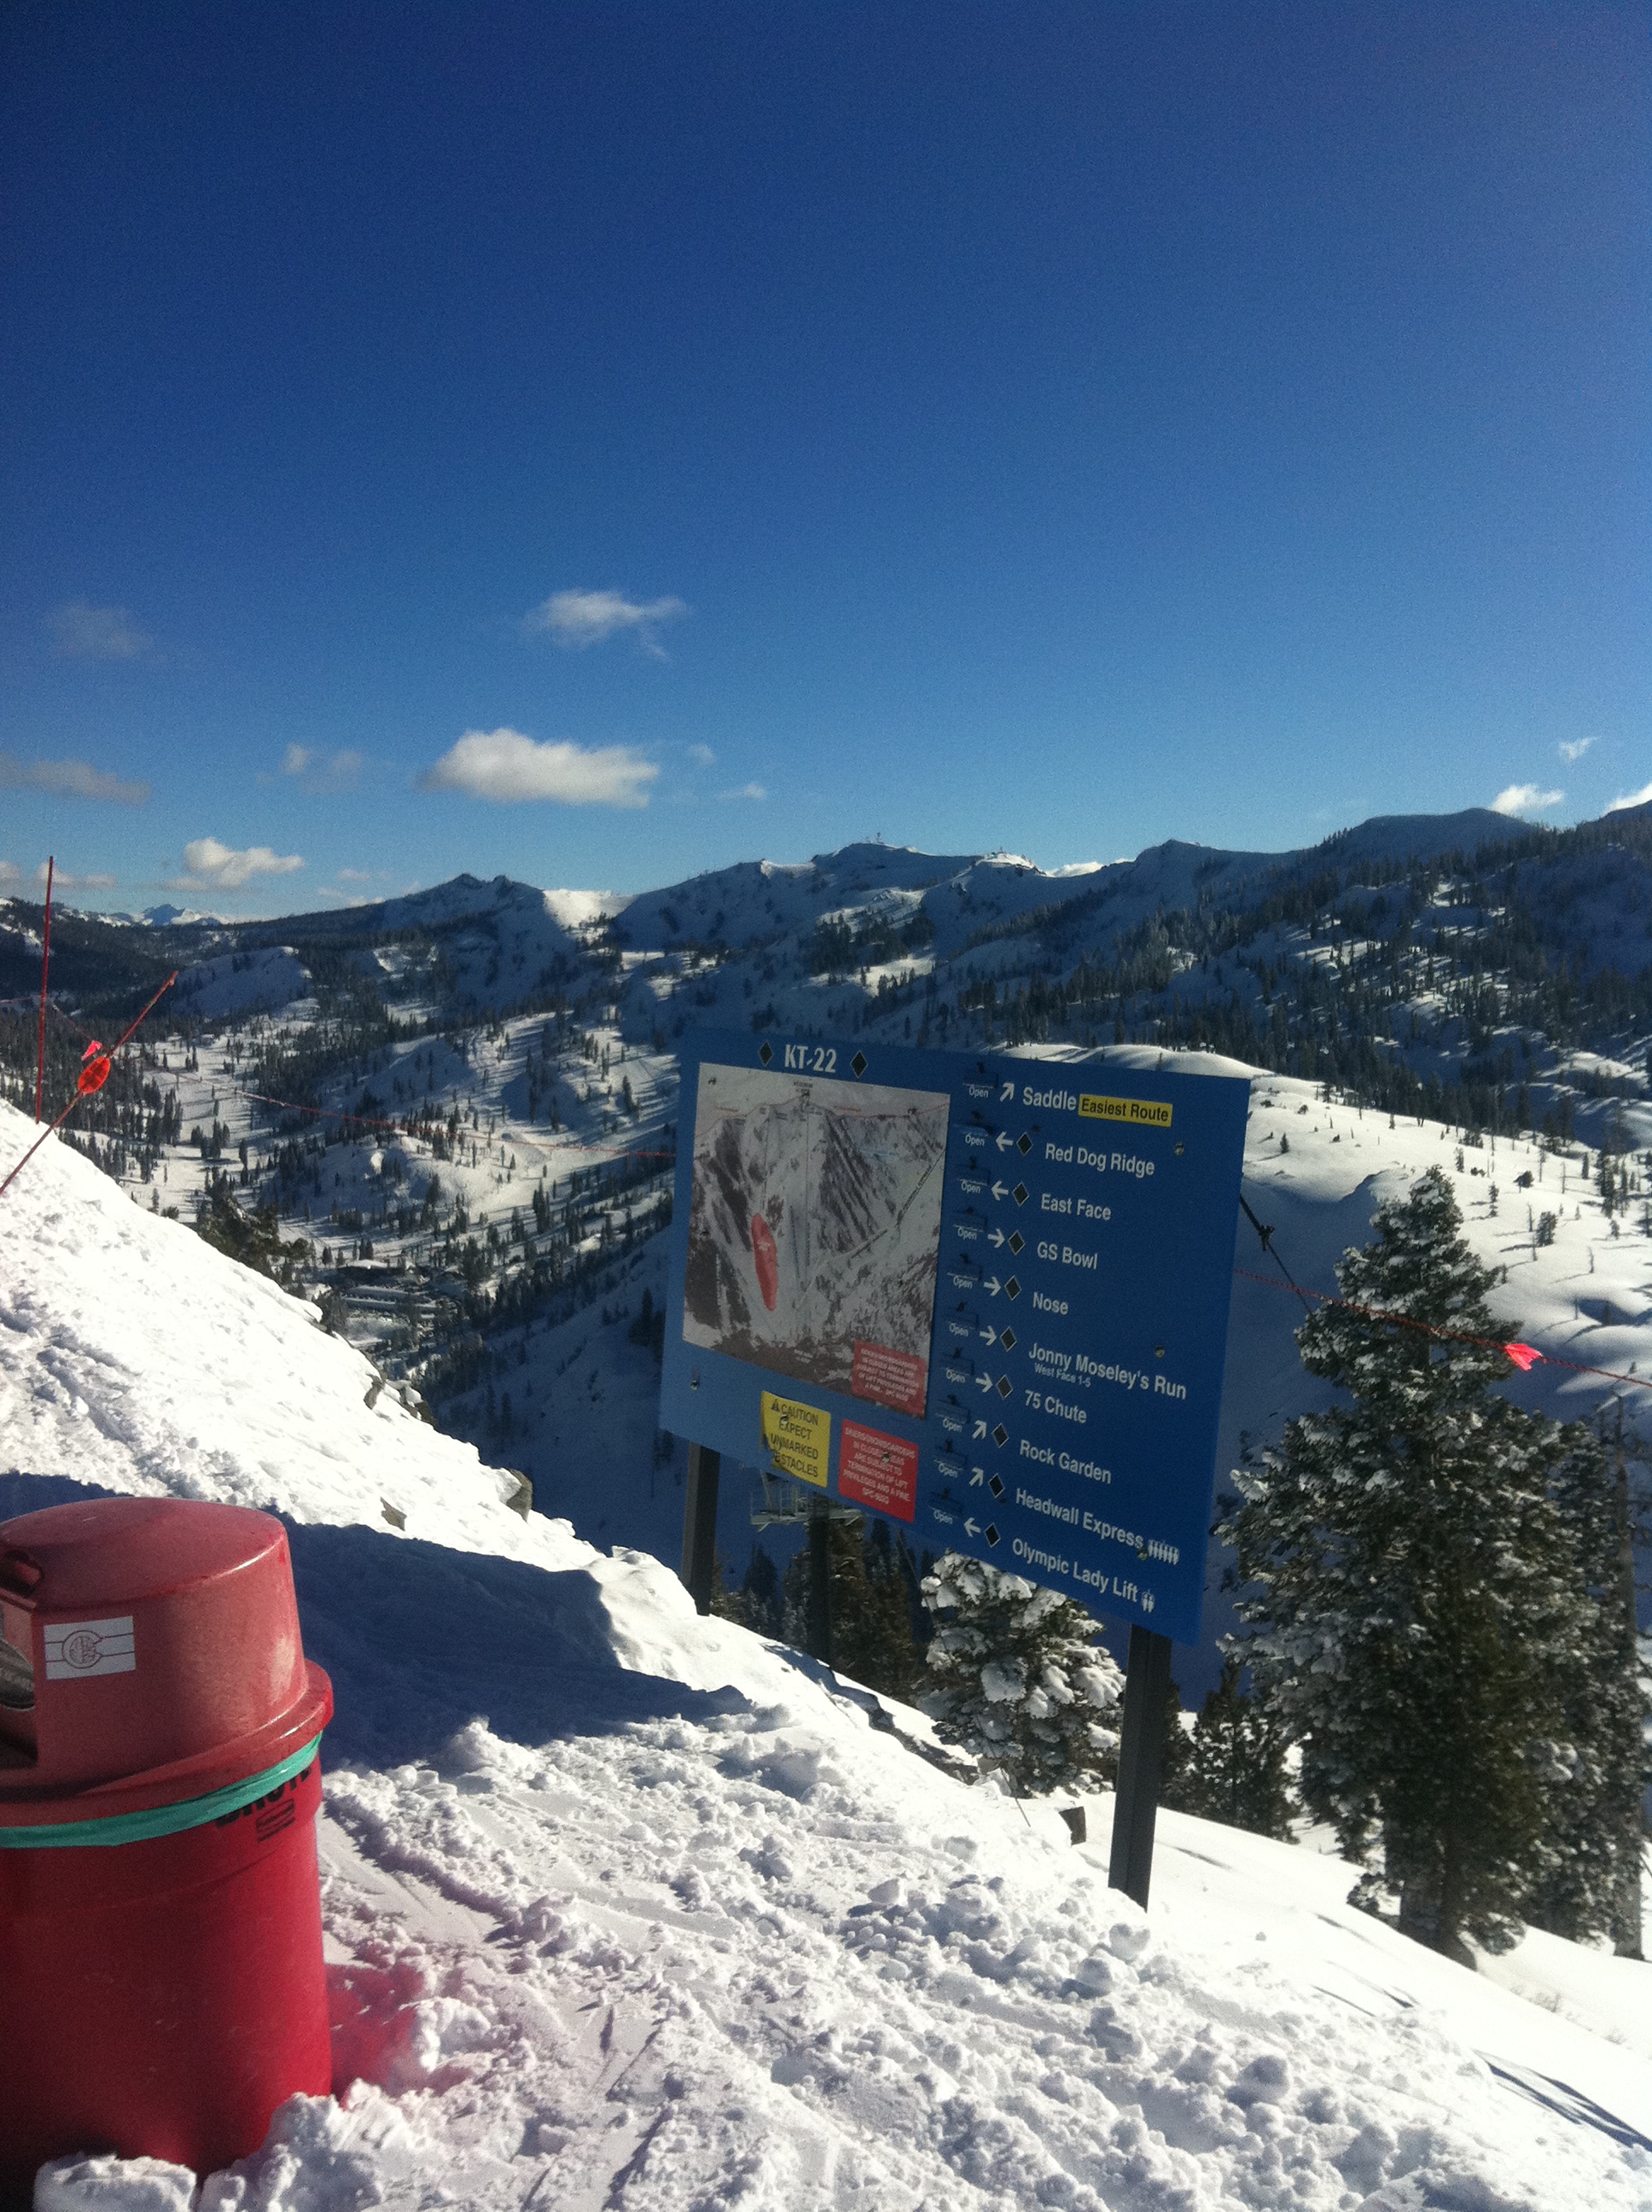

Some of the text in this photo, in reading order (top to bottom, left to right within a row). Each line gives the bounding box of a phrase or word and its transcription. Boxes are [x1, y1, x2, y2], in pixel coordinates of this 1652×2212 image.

[785, 1044, 837, 1074] KT-22
[969, 1086, 989, 1098] Open
[1023, 1087, 1168, 1122] Saddle Easiest Route
[965, 1133, 985, 1146] Open
[1045, 1144, 1155, 1177] Red Dog Ridge
[961, 1181, 980, 1194] Open
[1042, 1194, 1111, 1220] East Face
[957, 1228, 977, 1240] Open
[1038, 1243, 1098, 1270] GS Bowl
[953, 1277, 973, 1289] Open
[1032, 1292, 1068, 1315] Nose
[949, 1324, 969, 1336] Open
[945, 1369, 966, 1383] Open
[1029, 1343, 1187, 1400] Jonny Moseley's Run
[1034, 1363, 1054, 1377] West
[1056, 1369, 1076, 1384] Face
[781, 1404, 818, 1425] CAUTION
[1025, 1390, 1087, 1423] 75 Chute
[779, 1419, 812, 1440] EXPECT
[943, 1418, 963, 1433] Open
[771, 1434, 818, 1459] UNMARKED
[938, 1463, 957, 1478] Open
[1020, 1440, 1111, 1484] Rock Garden
[934, 1510, 953, 1524] Open
[1016, 1488, 1144, 1549] Headwall Express
[1013, 1538, 1138, 1603] Olympic Lady Lift
